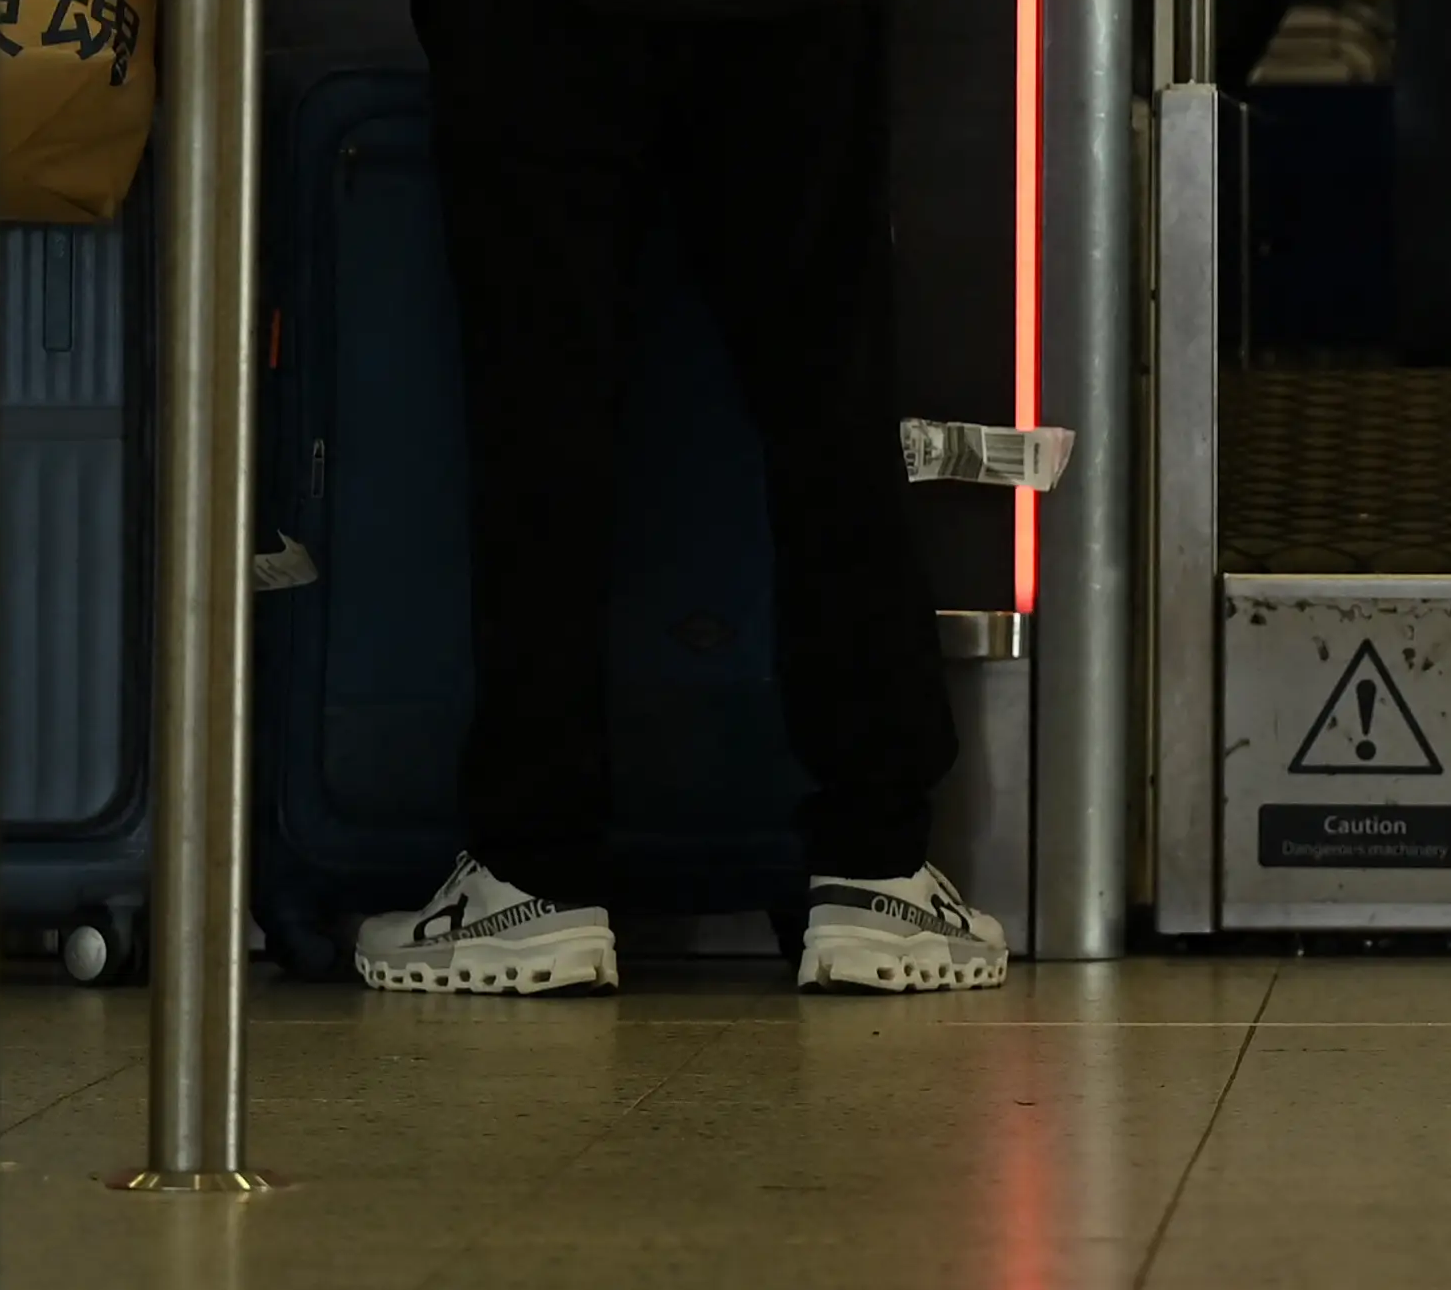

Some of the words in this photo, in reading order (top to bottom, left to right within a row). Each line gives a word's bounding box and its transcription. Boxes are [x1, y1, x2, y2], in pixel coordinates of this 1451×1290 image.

[1323, 815, 1407, 835] Caution
[1370, 840, 1449, 859] machinery
[871, 895, 904, 918] ON
